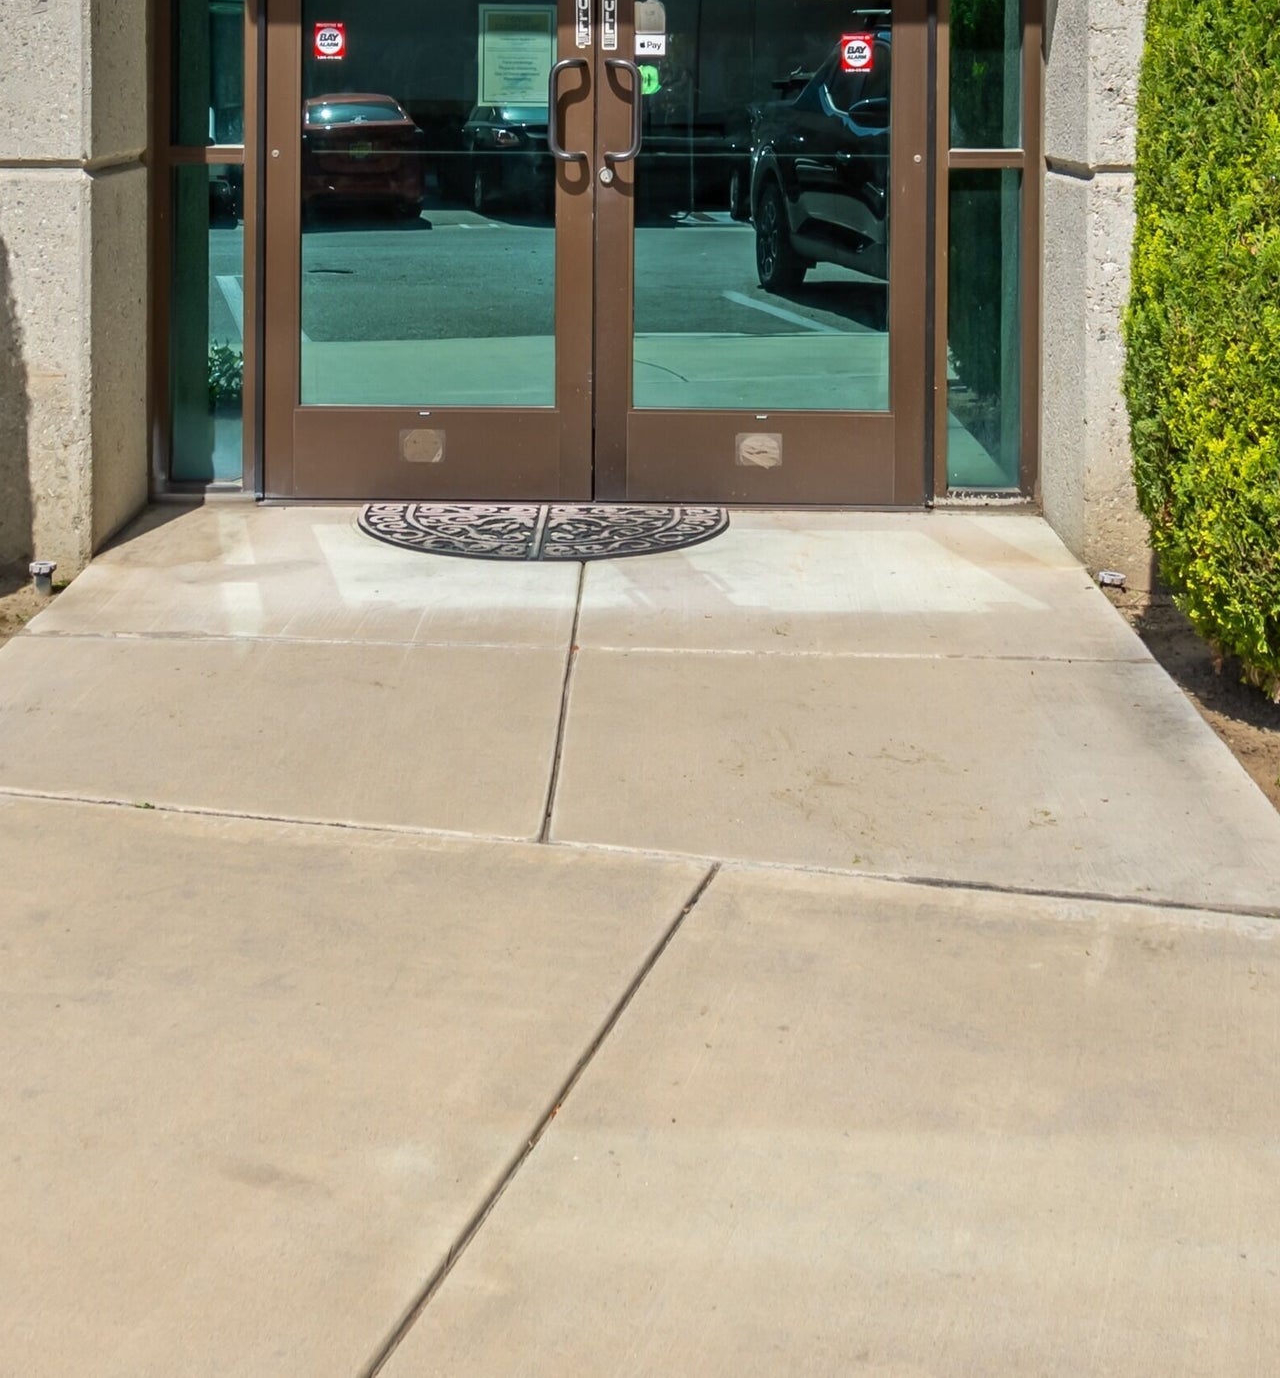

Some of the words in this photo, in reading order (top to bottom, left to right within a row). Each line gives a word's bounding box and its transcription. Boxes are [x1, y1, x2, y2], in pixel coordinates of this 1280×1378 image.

[319, 33, 339, 42] BAY
[646, 41, 662, 51] Pay
[847, 46, 867, 54] BAY
